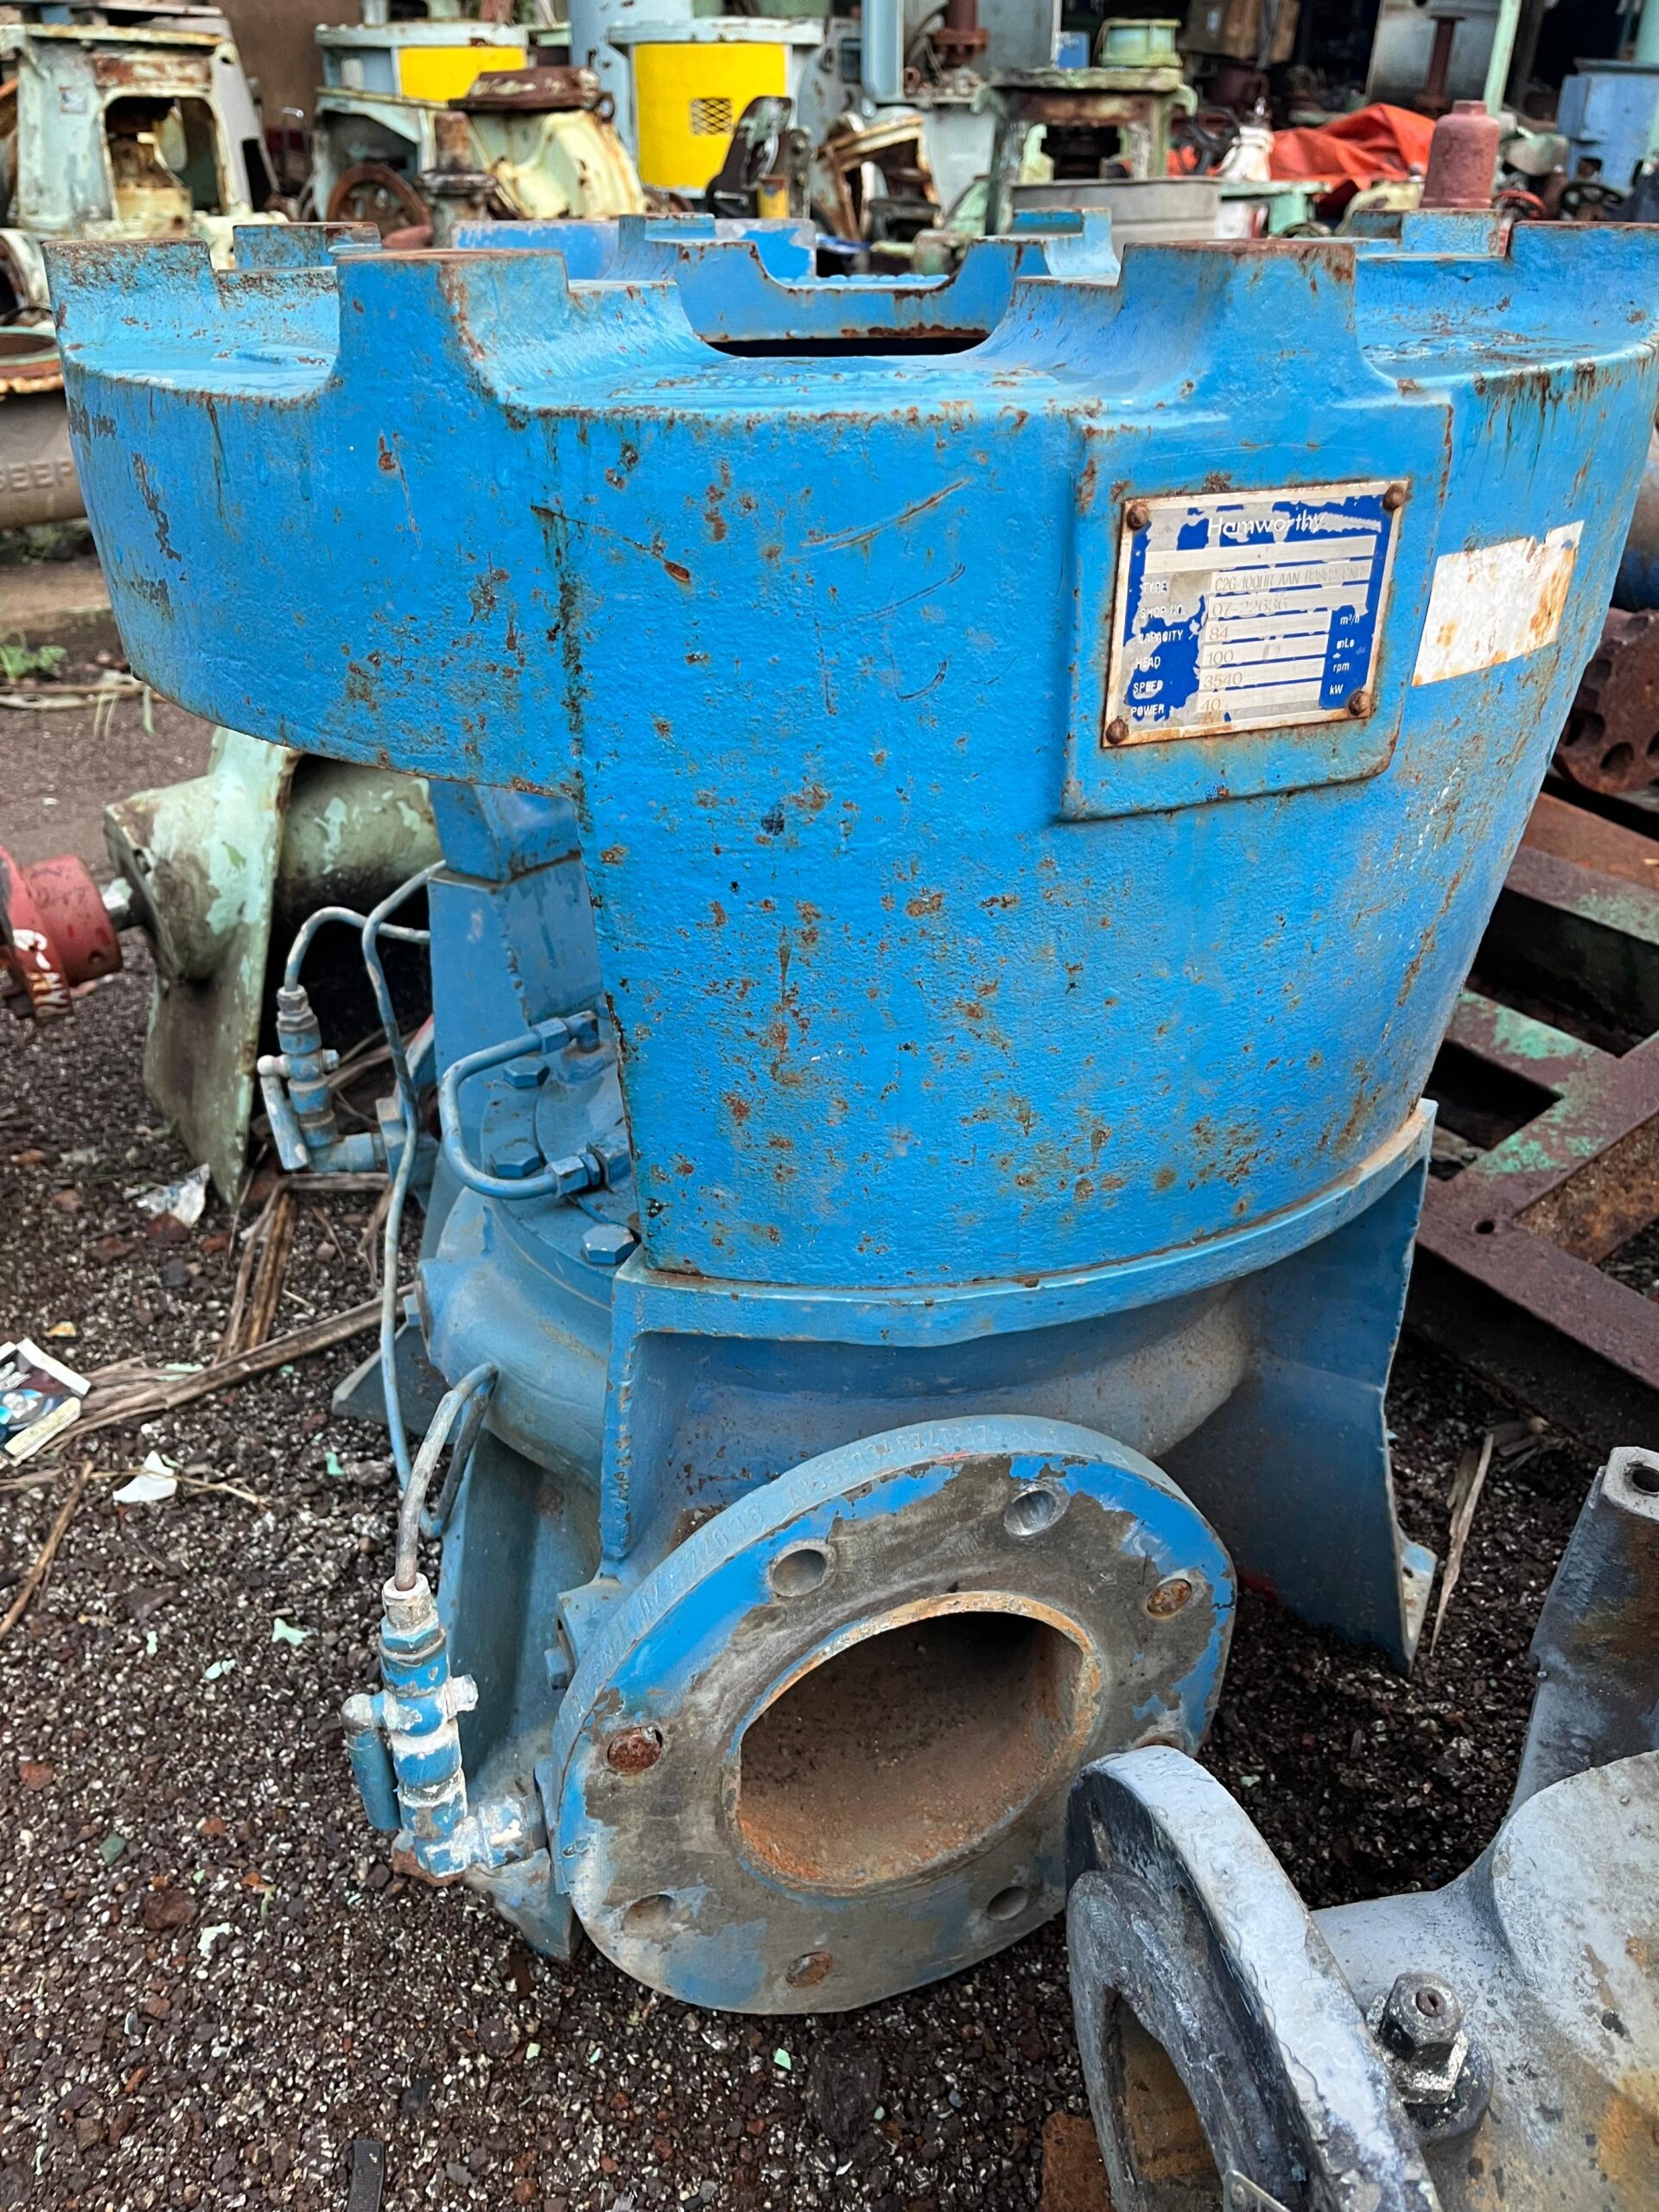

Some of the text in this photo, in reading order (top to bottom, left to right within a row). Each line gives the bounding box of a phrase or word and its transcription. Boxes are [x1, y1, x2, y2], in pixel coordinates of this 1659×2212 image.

[1207, 508, 1325, 537] Hamworthy
[1142, 582, 1167, 594] TYPE
[1140, 607, 1168, 620] SHOP
[1138, 630, 1183, 644] CAPACITY
[1209, 626, 1228, 640] 84
[1136, 656, 1161, 669] HEAD
[1209, 650, 1233, 665] 100
[1134, 663, 1350, 694] SPEED 3540 rpm
[1131, 683, 1344, 716] POWER 40 kW
